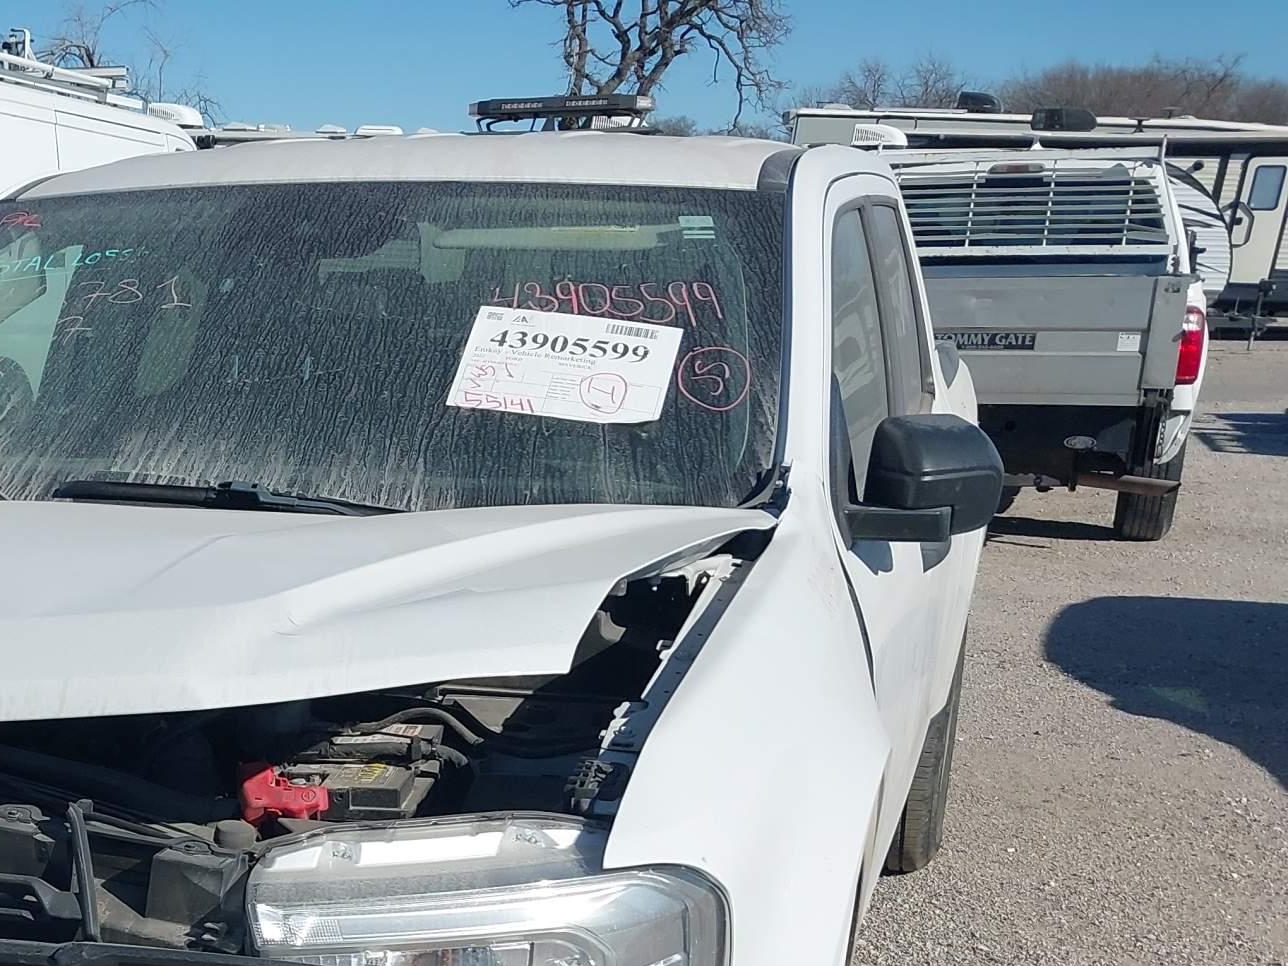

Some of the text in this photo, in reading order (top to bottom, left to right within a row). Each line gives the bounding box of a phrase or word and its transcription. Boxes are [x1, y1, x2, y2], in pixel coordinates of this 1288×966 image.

[493, 281, 723, 327] 43905599
[489, 329, 650, 364] 43905599
[935, 331, 1034, 345] TOMMY GATE
[463, 391, 535, 414] 55141
